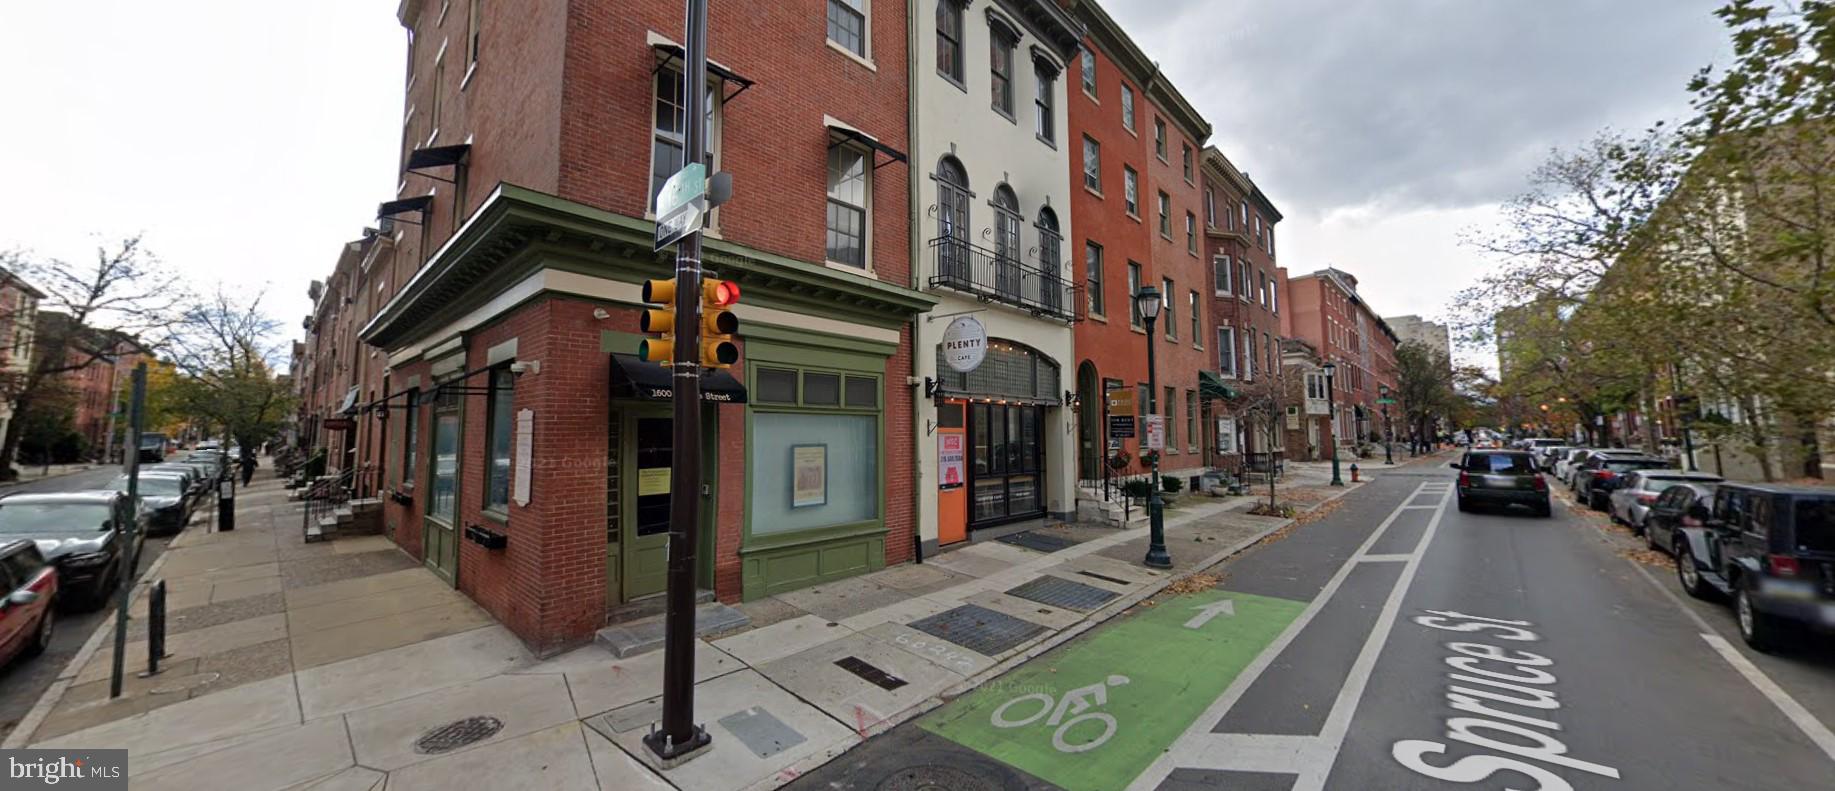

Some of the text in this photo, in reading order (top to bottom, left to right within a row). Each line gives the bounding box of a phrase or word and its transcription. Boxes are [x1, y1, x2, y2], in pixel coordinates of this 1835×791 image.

[947, 338, 981, 350] PLENTY
[652, 389, 672, 398] 1600
[705, 392, 731, 401] Street
